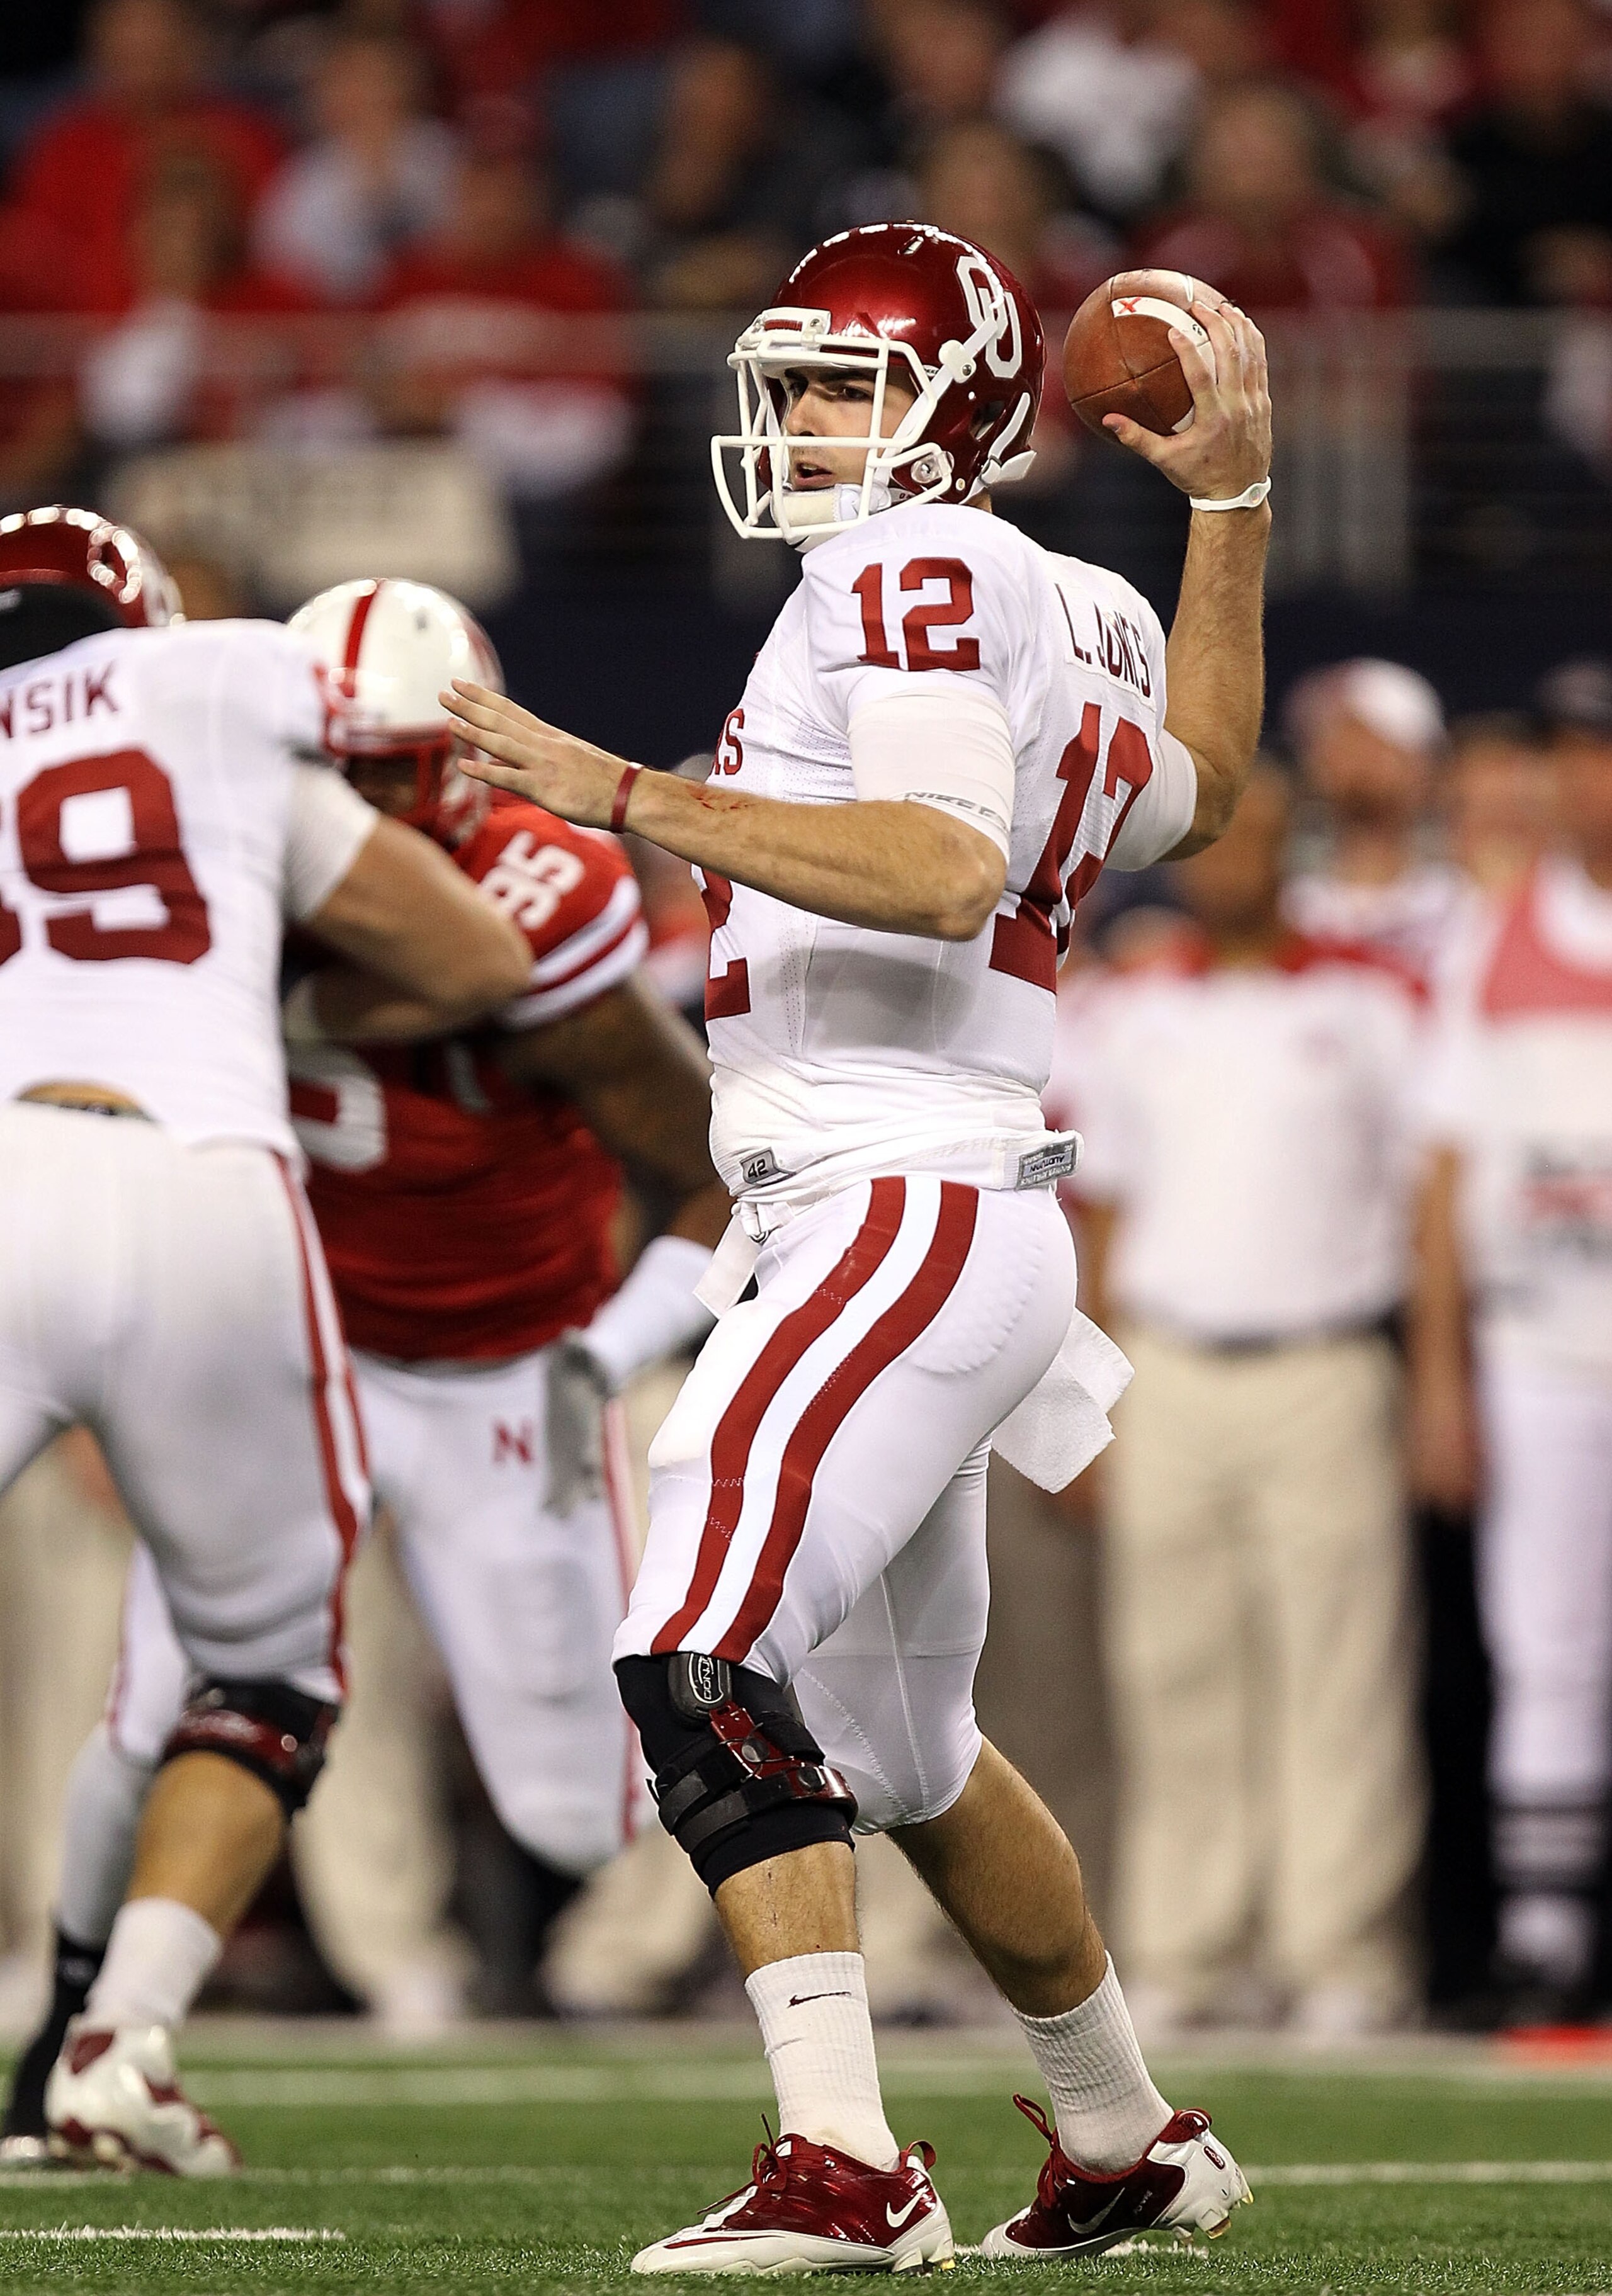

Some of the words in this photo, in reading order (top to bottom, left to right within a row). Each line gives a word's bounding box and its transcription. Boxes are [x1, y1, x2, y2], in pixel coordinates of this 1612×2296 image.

[852, 557, 980, 672] 12
[1054, 582, 1093, 665] L.
[0, 744, 212, 966] 9
[989, 701, 1154, 996] 12
[747, 1158, 769, 1178] 42
[493, 1418, 533, 1467] N
